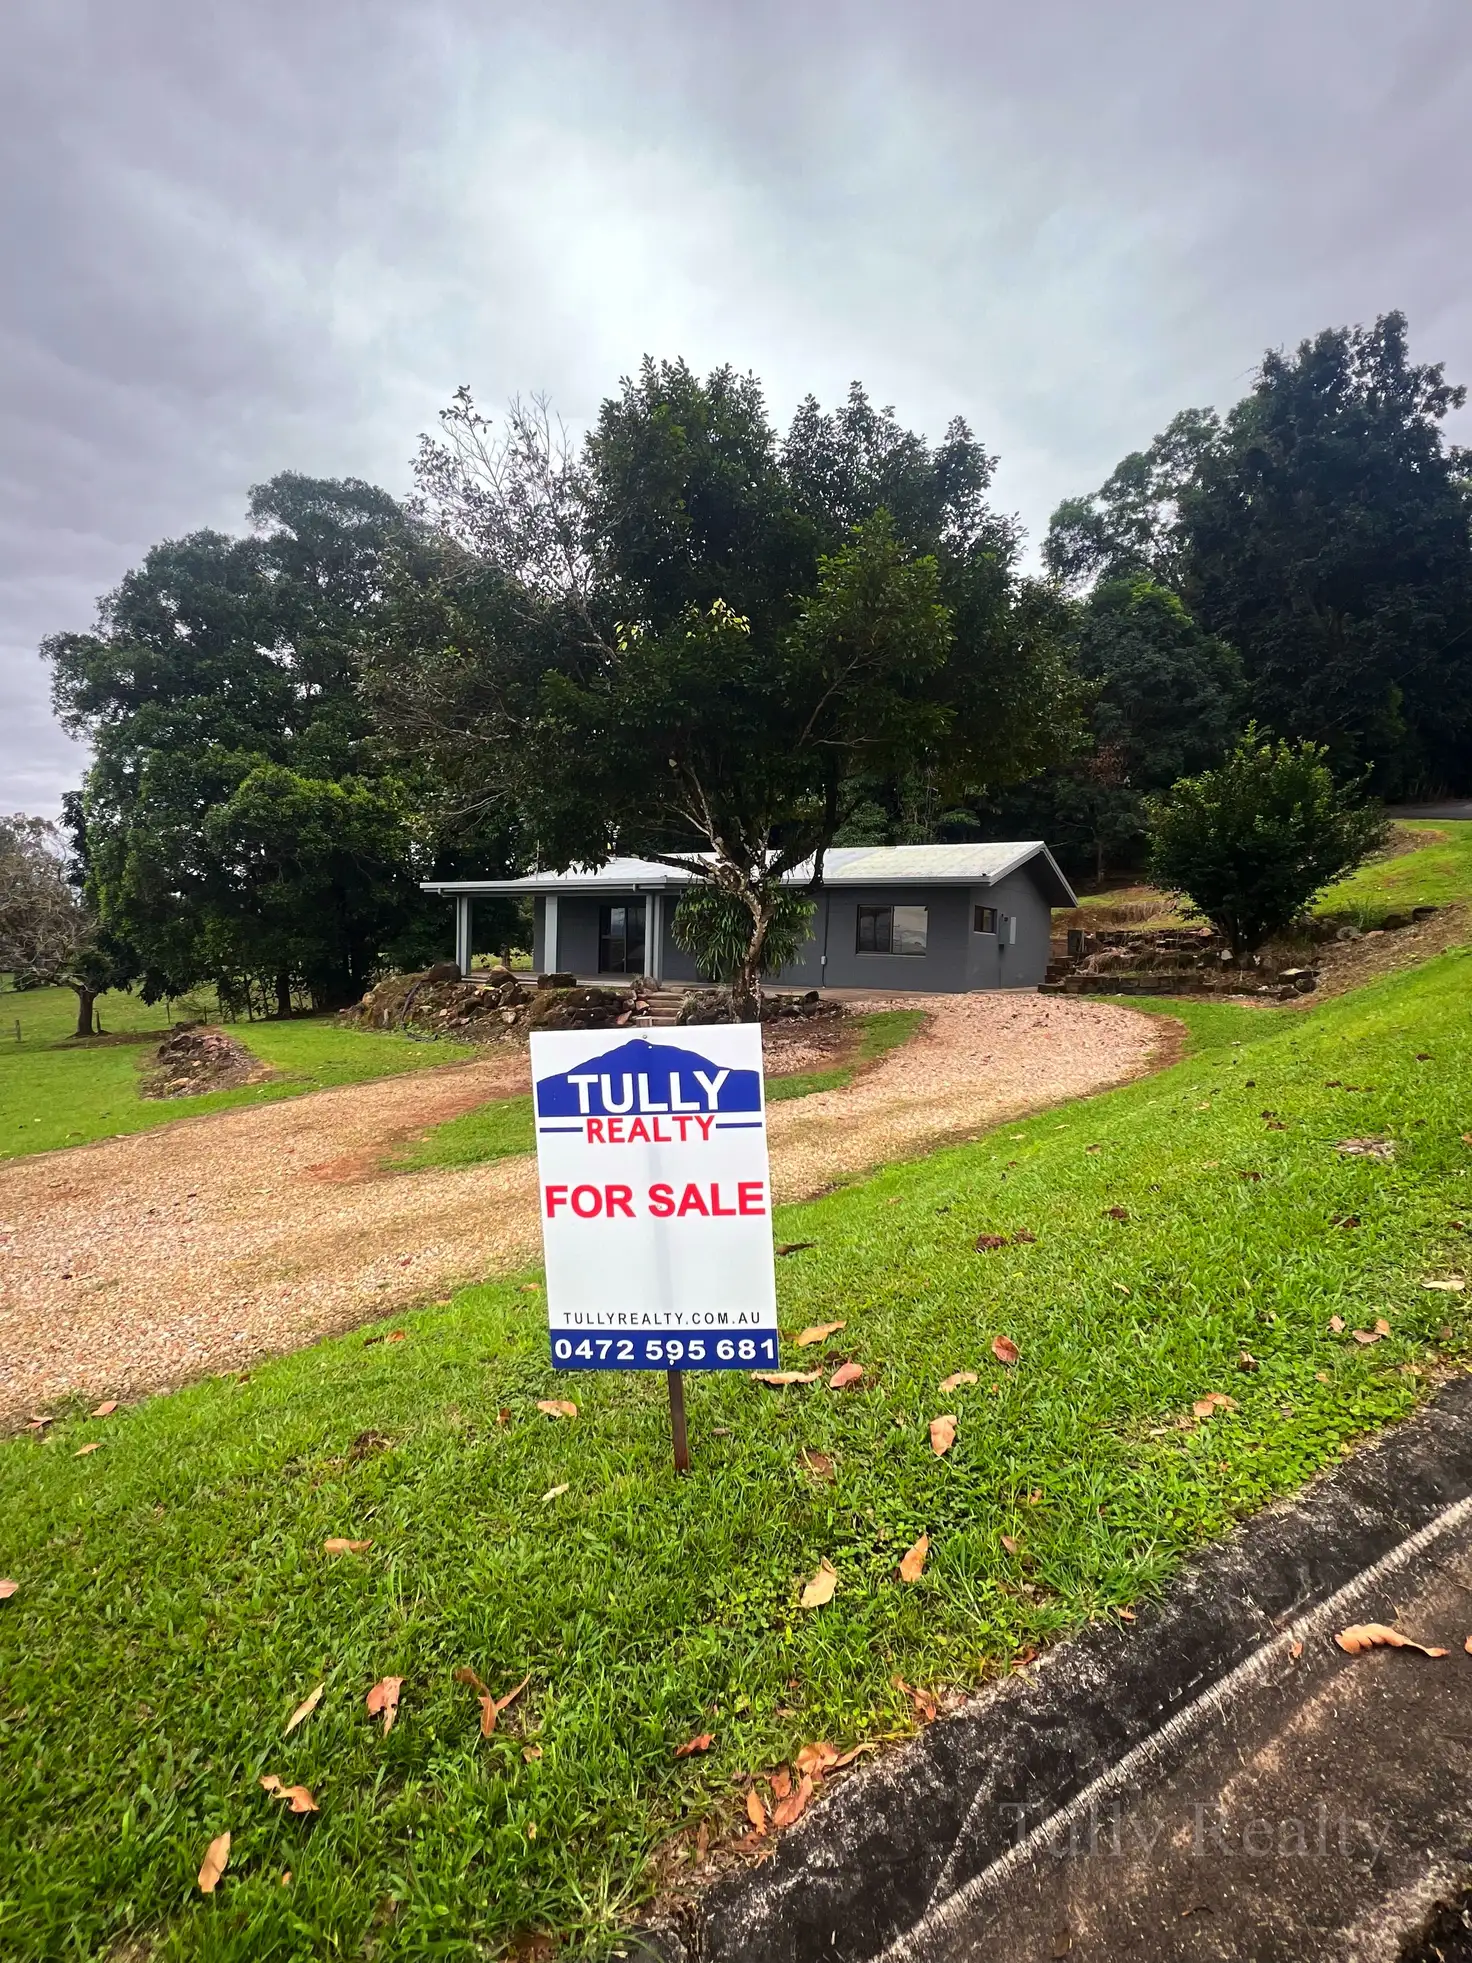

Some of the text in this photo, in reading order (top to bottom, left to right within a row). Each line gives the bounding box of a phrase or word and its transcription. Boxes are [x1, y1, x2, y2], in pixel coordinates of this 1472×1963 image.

[567, 1069, 731, 1114] TULLY
[586, 1115, 716, 1144] REALTY
[545, 1181, 766, 1218] FOR SALE
[563, 1311, 761, 1326] TULLYREALTY.COM.AU
[554, 1338, 775, 1361] 0472 595 681
